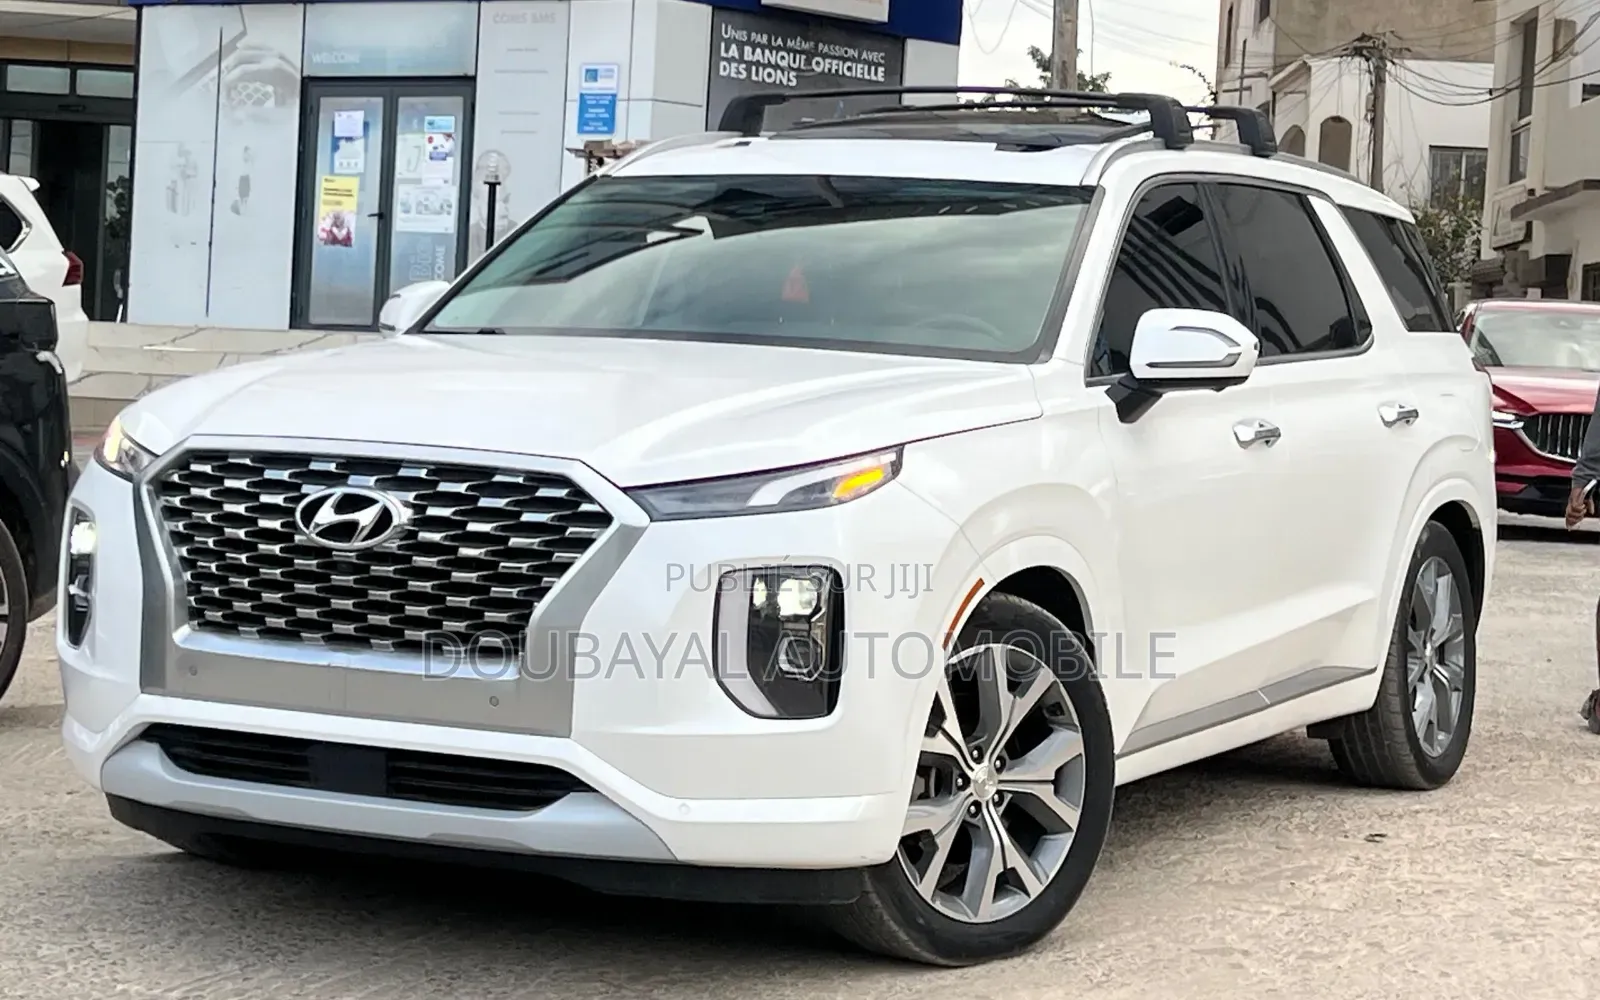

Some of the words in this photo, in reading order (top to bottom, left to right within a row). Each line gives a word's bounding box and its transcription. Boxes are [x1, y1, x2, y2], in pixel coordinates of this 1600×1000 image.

[720, 41, 739, 60] LA
[744, 45, 812, 71] BANQUE
[811, 56, 885, 82] OFFICIELLE
[721, 22, 748, 42] UNIS
[751, 31, 768, 45] PAR
[771, 34, 784, 48] LA
[818, 42, 859, 60] PASSION
[861, 50, 885, 64] AVEC
[719, 61, 747, 79] DES
[751, 65, 798, 87] LIONS
